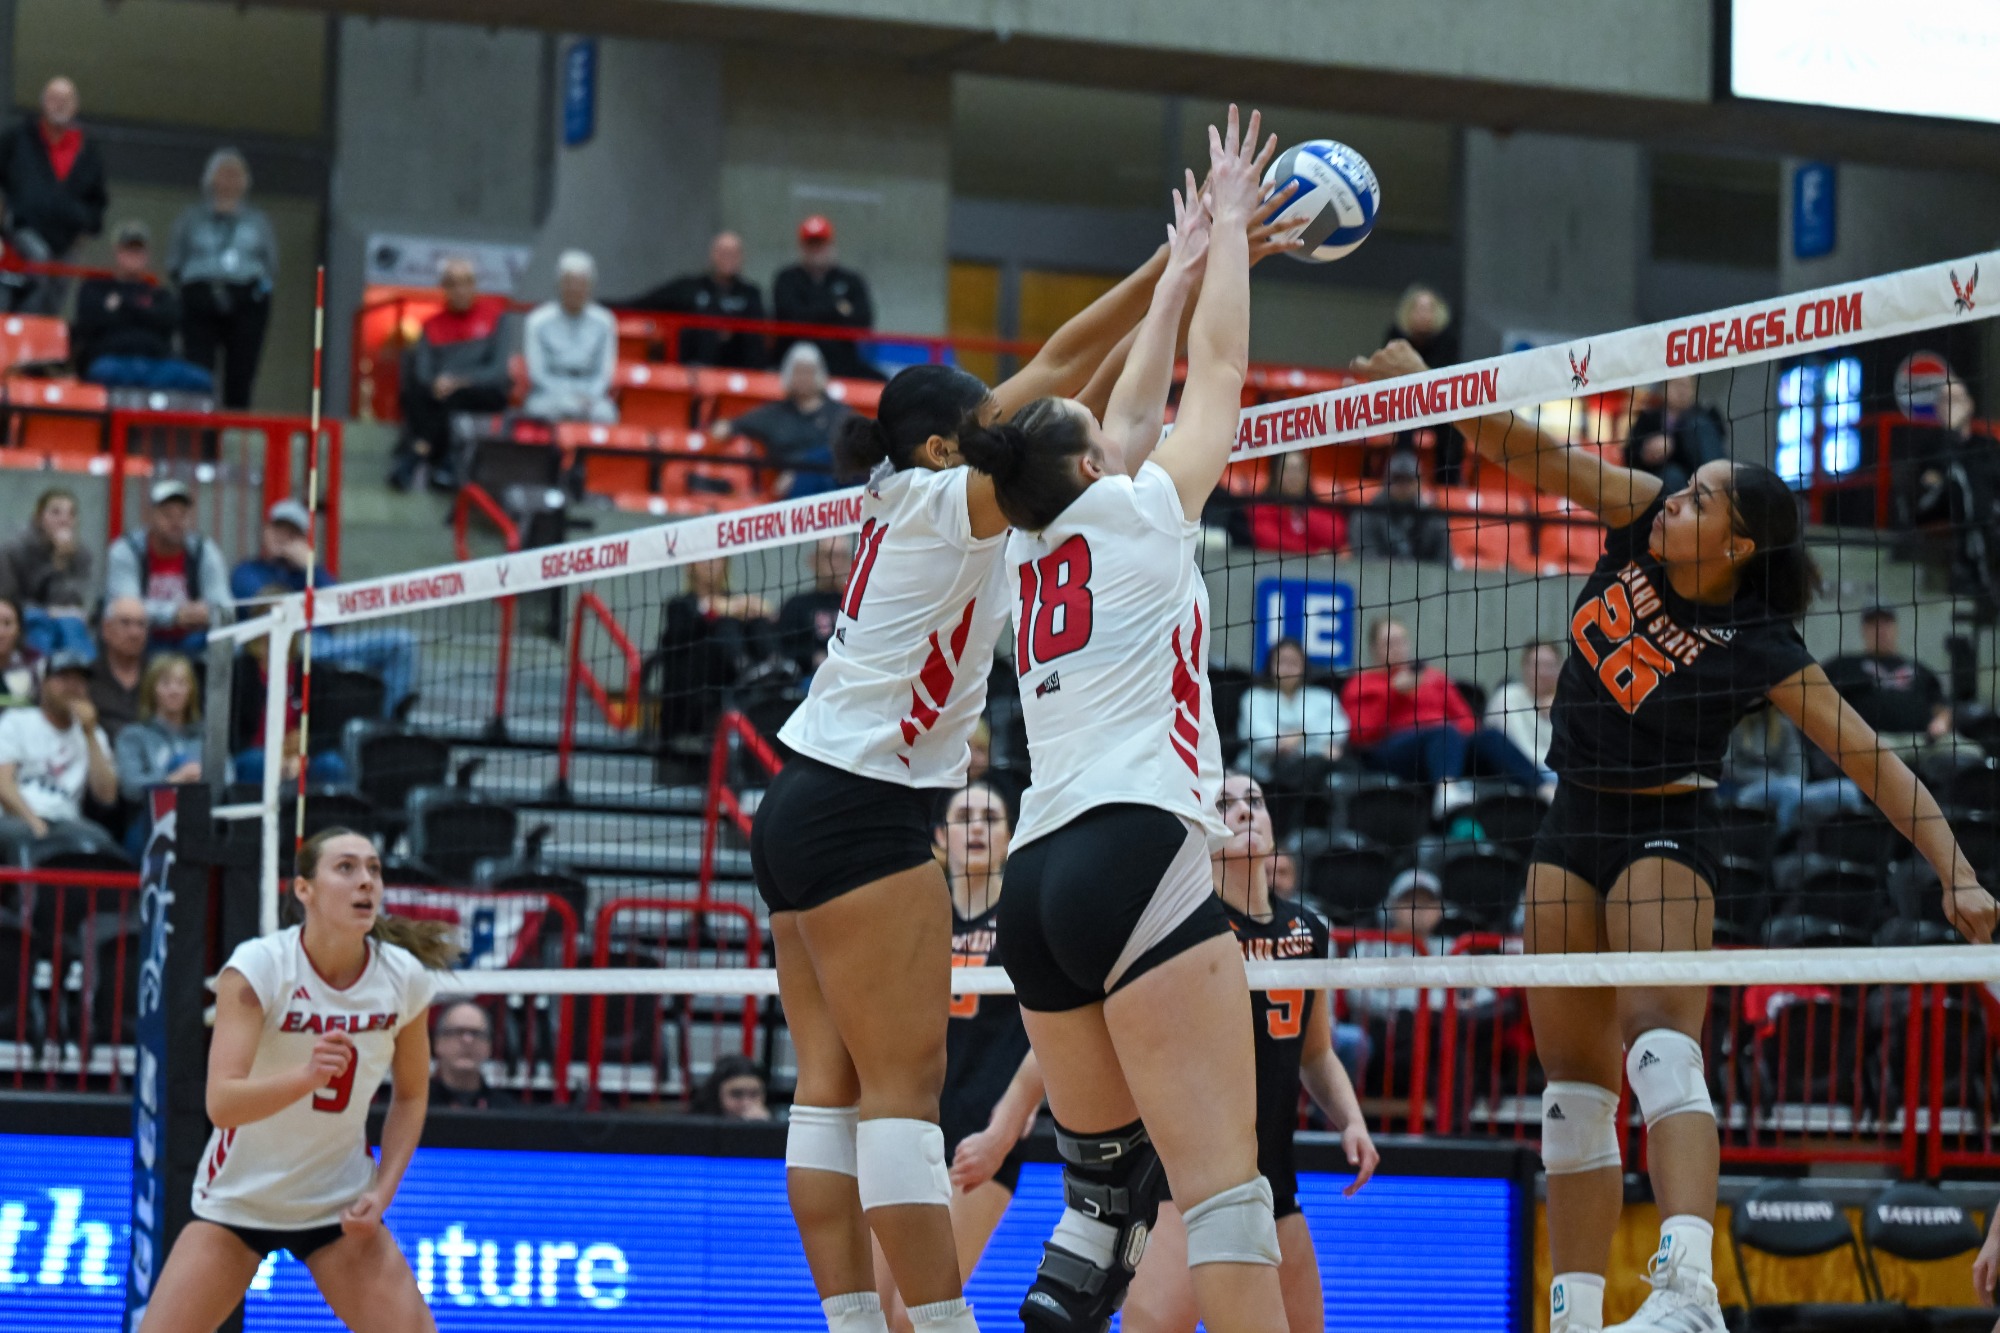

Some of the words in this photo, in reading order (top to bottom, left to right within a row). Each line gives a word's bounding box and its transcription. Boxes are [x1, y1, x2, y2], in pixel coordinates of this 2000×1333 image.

[1666, 292, 1863, 367] GOEAGS.COM
[1334, 367, 1499, 432] WASHINGTON
[717, 511, 786, 548] EASTERN
[840, 516, 889, 621] 11
[1018, 534, 1093, 678] 18
[1571, 581, 1676, 715] 26
[1647, 613, 1707, 667] STATE
[1746, 1201, 1835, 1222] EASTERN
[1877, 1205, 1964, 1225] EASTERN
